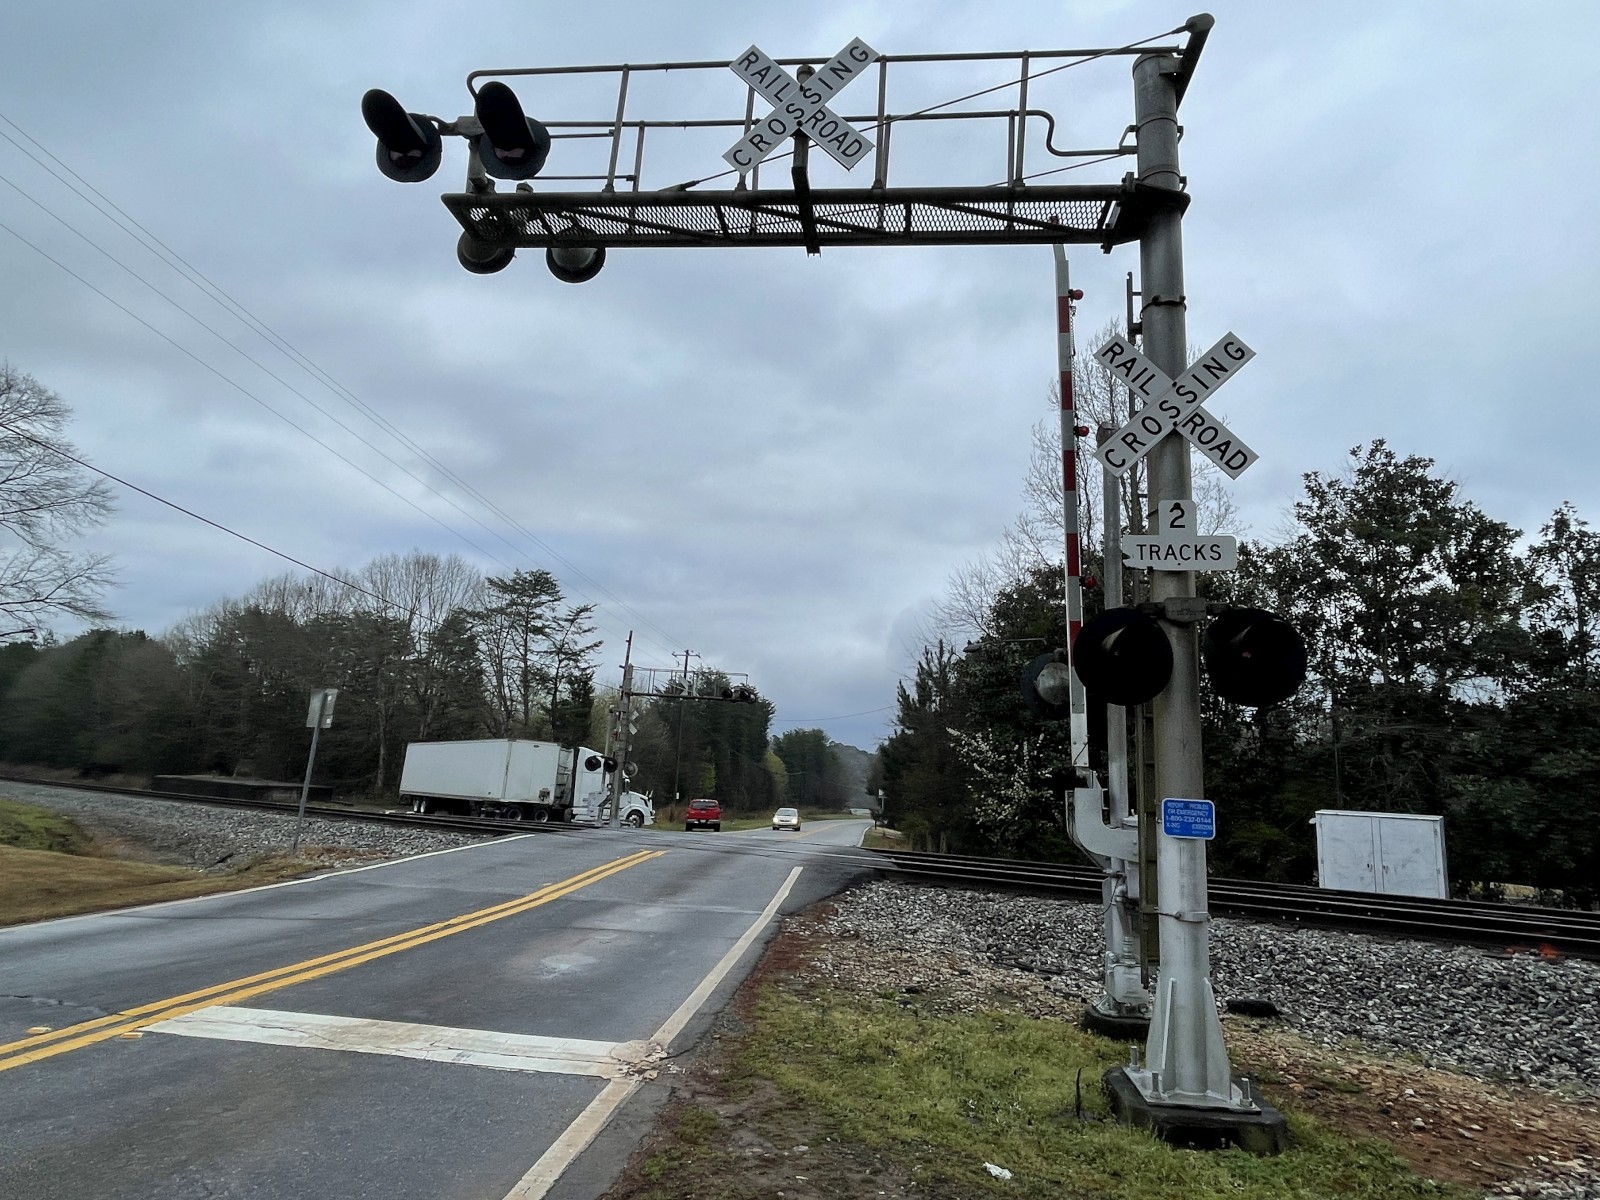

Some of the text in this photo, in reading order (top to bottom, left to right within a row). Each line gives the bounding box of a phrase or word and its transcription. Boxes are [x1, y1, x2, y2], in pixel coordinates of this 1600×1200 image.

[733, 46, 869, 167] CROSSING
[738, 51, 863, 158] RAIL ROAD
[1101, 341, 1248, 472] RAIL ROAD
[1105, 341, 1246, 468] CROSSING
[1136, 543, 1222, 561] TRACKS
[1169, 502, 1186, 529] 2
